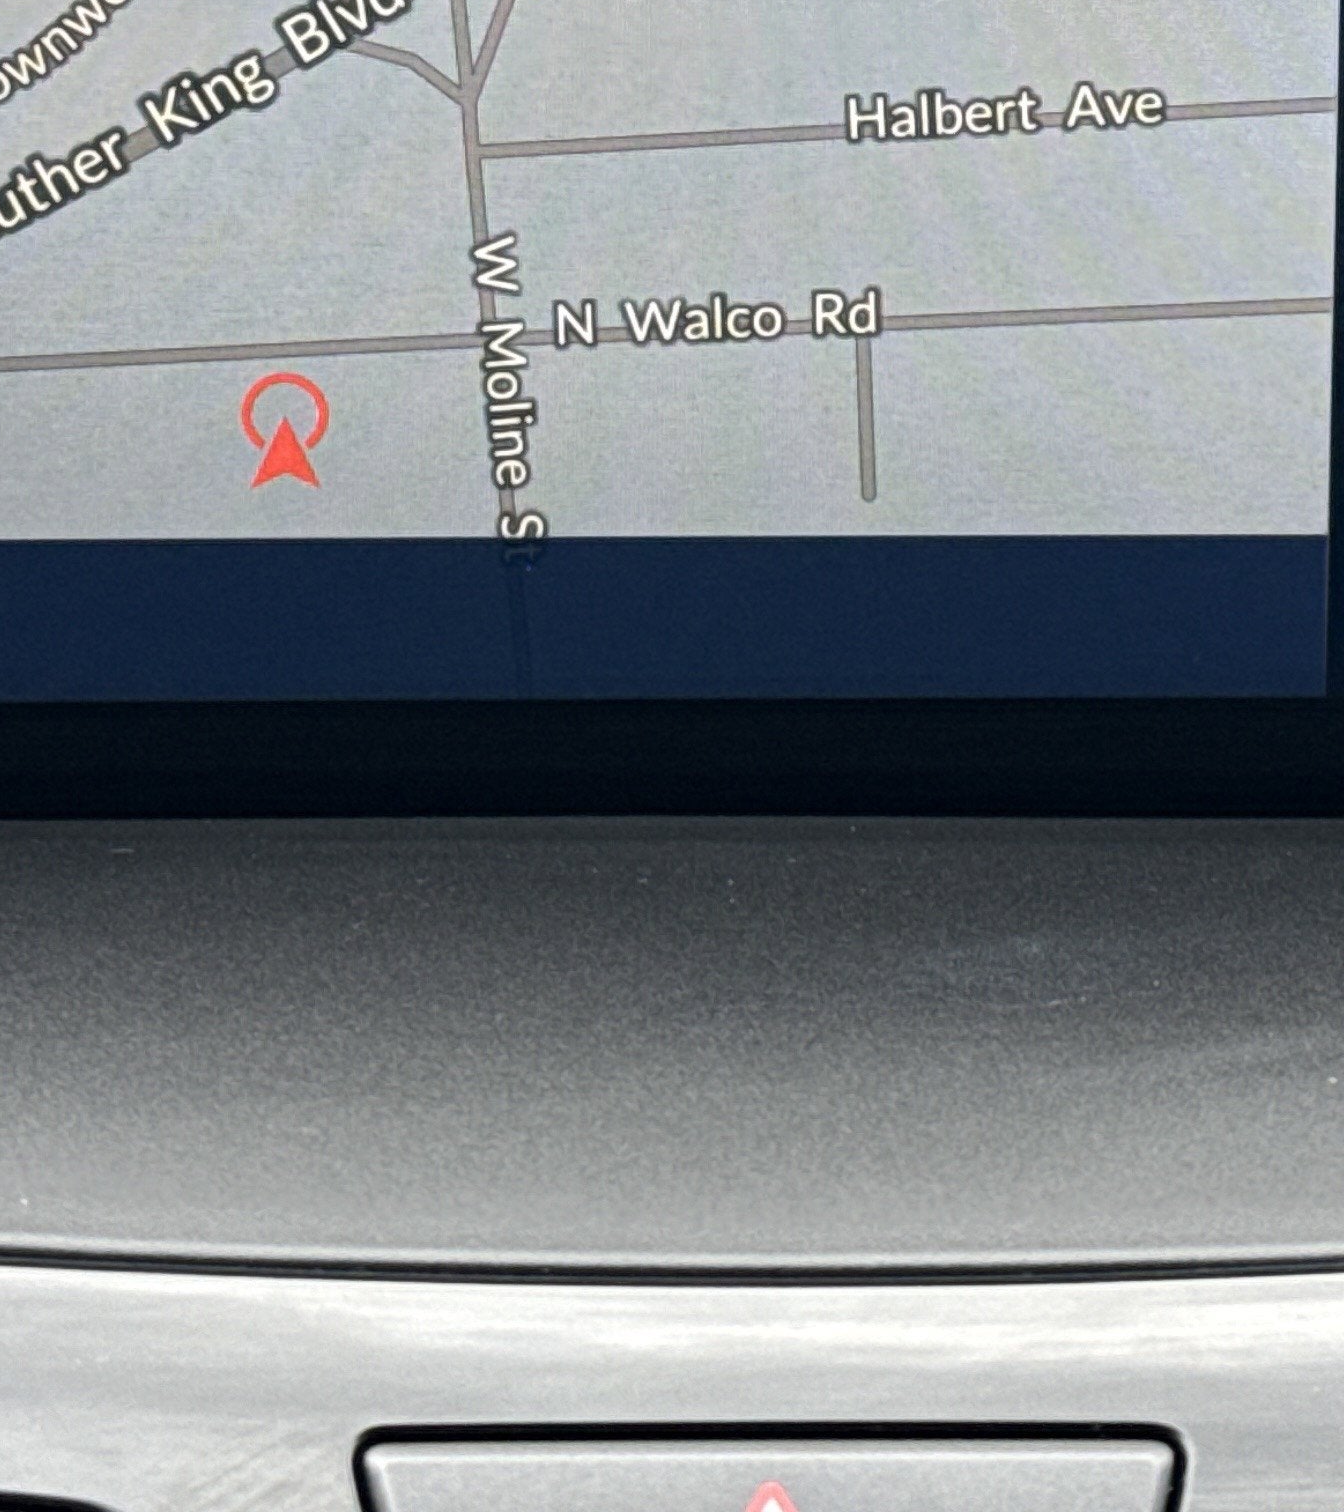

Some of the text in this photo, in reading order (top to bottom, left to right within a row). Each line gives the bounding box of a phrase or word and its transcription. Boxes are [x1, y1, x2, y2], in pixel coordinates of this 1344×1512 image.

[145, 56, 274, 141] King
[847, 85, 1163, 139] Halbert Ave
[473, 233, 518, 292] W
[557, 289, 878, 345] N Walco Rd
[481, 321, 536, 487] Moline
